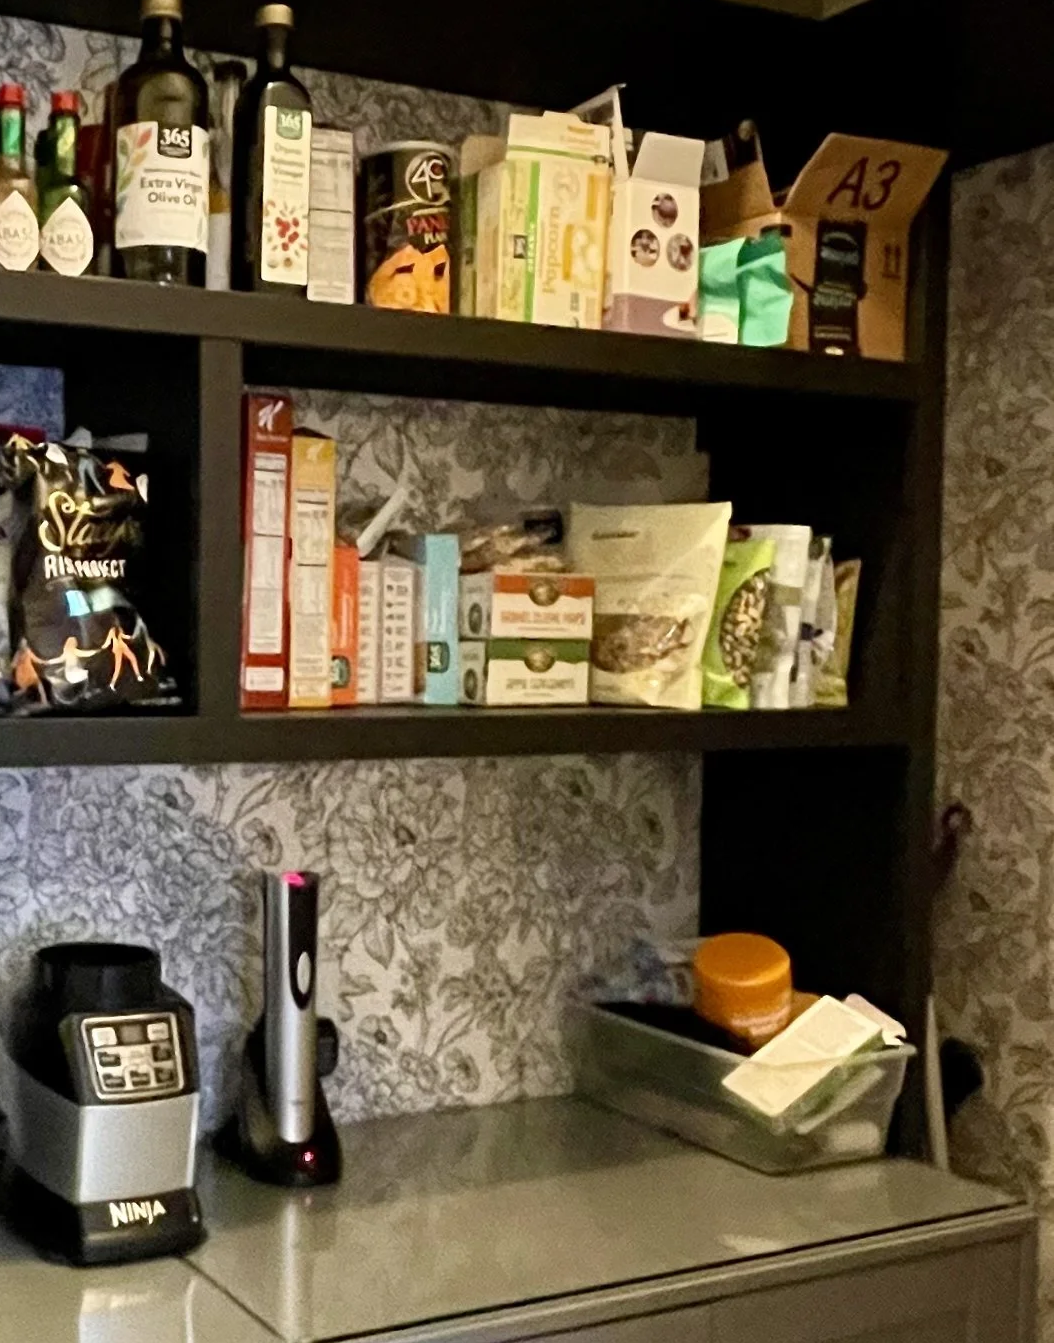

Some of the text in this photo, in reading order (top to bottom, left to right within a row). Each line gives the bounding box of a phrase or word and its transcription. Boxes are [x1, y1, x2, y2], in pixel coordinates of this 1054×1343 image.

[160, 128, 191, 148] 365
[140, 177, 172, 189] Extra
[411, 159, 444, 199] 4C
[826, 156, 901, 211] A3
[148, 191, 181, 203] Olive
[543, 205, 562, 294] Popcorn
[109, 1198, 167, 1228] NINJA
